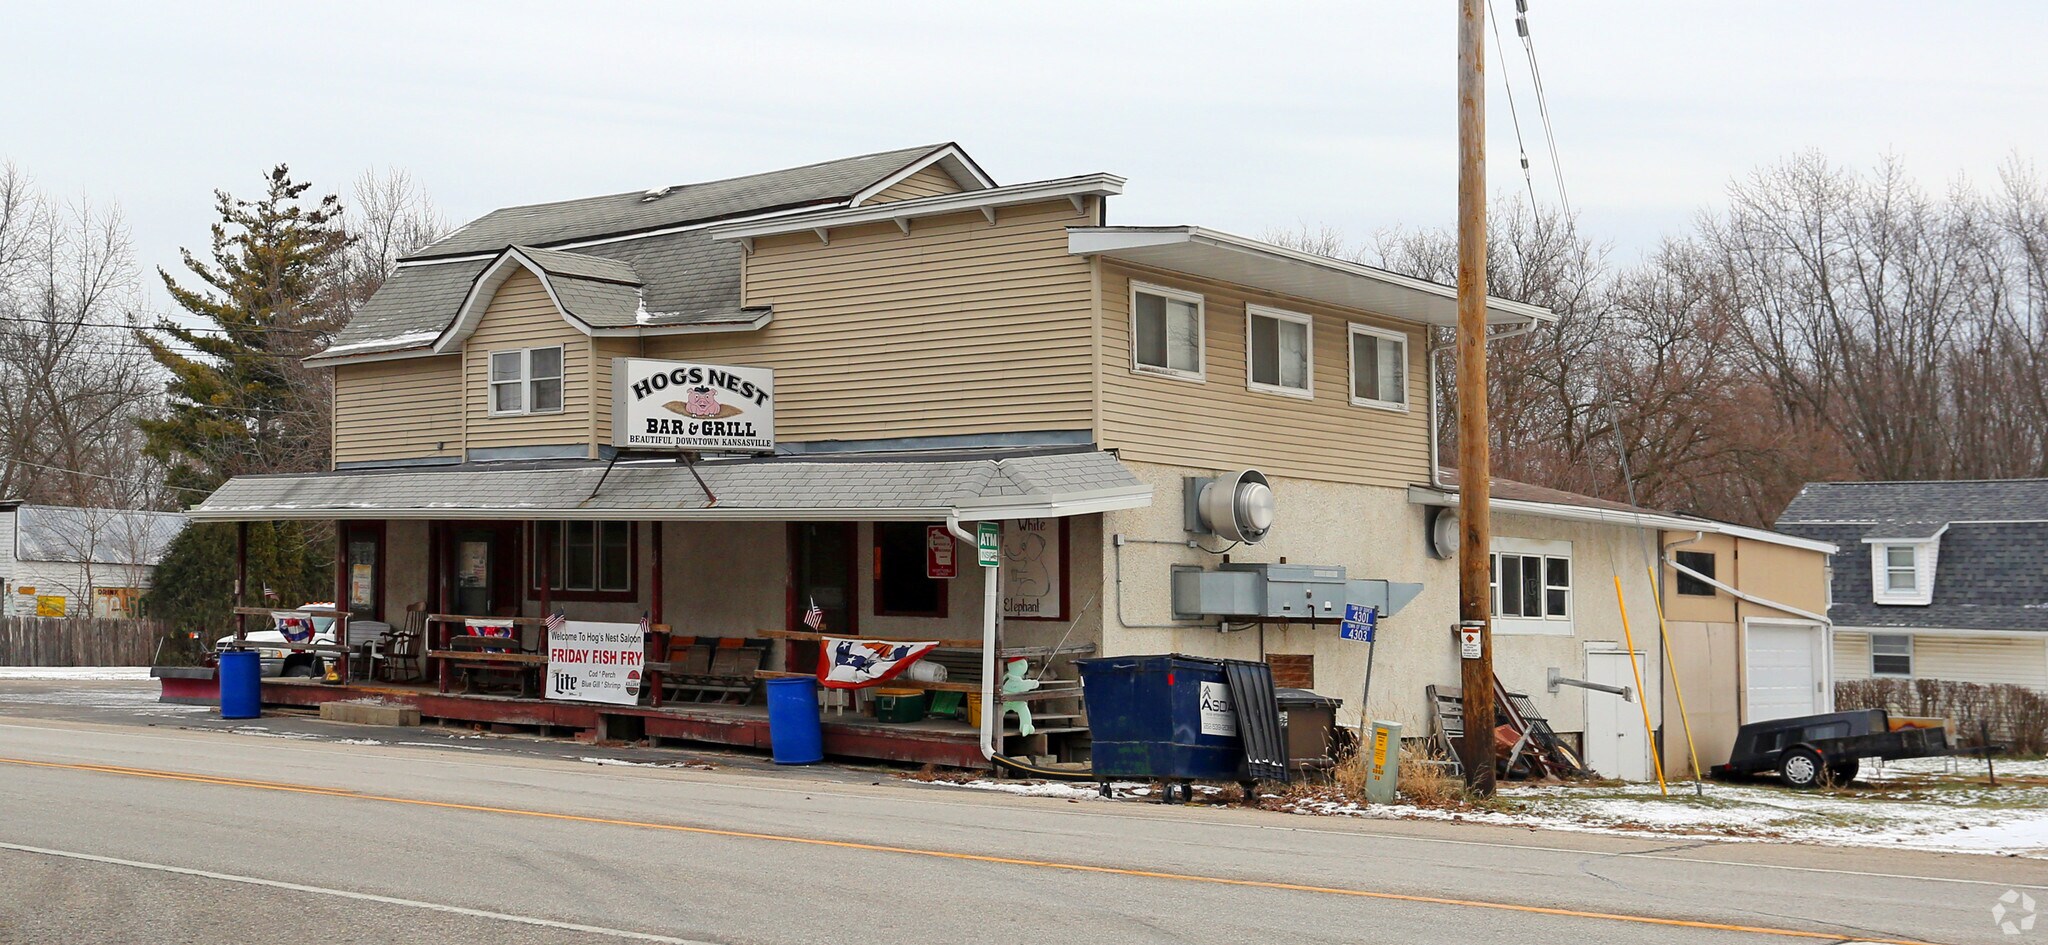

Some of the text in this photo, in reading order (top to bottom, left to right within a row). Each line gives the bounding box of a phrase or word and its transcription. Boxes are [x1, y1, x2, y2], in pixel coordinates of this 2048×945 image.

[630, 367, 770, 408] HOGS NEST
[646, 418, 757, 437] BAR & GRILL
[629, 435, 771, 447] BEAUTIFUL DOWNTOWN KANSASVILLE
[1017, 518, 1046, 531] White
[980, 532, 997, 547] ATM
[1003, 597, 1040, 616] Elephant
[1353, 611, 1369, 623] 4301
[551, 632, 642, 644] Welcome To Hog's Nest Saloon
[1348, 629, 1367, 640] 4303
[551, 648, 643, 666] FRIDAY FISH FRY
[602, 671, 616, 679] Perch
[554, 672, 578, 695] Lite
[581, 680, 621, 690] Blue Gill Shrimp
[1202, 698, 1234, 712] ASDA
